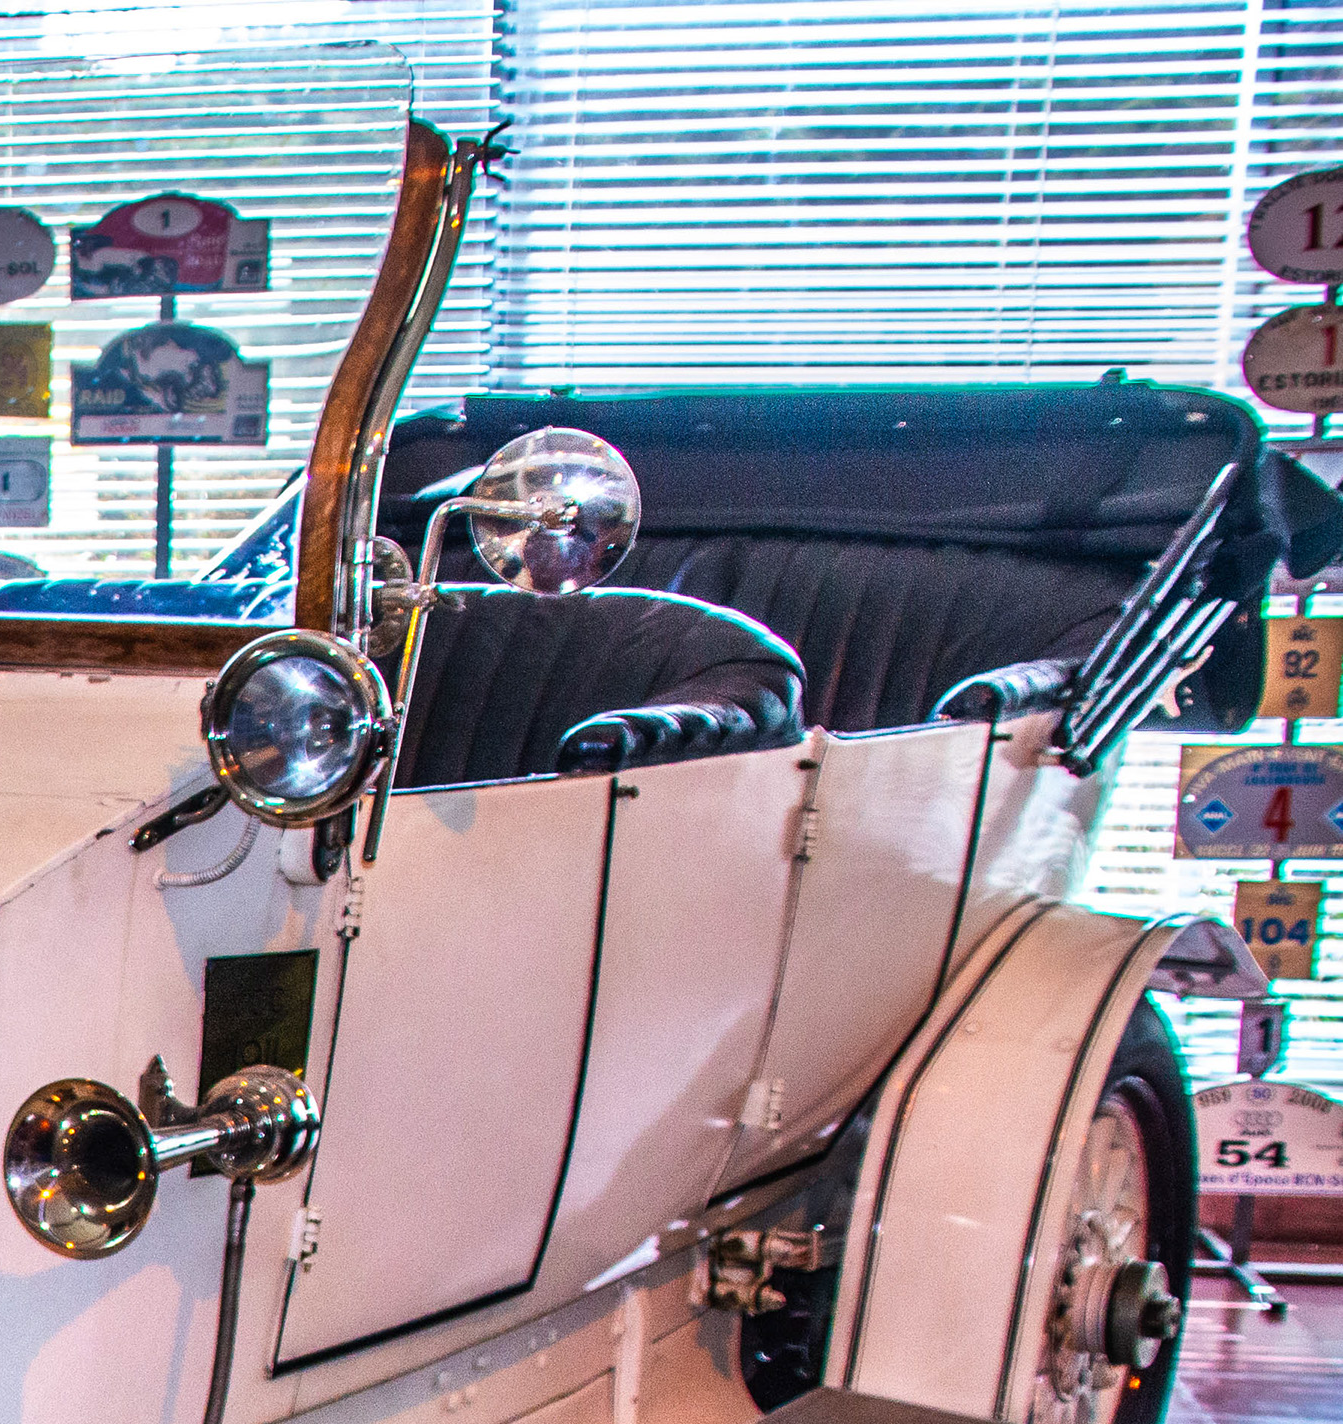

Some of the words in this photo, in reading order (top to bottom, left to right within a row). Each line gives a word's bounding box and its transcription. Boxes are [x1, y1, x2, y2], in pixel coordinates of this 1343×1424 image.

[161, 209, 171, 230] 1
[80, 388, 126, 405] RAID
[1263, 787, 1295, 842] 4
[1241, 916, 1310, 946] 104
[1258, 1018, 1272, 1052] 1
[1214, 1139, 1290, 1170] 54
